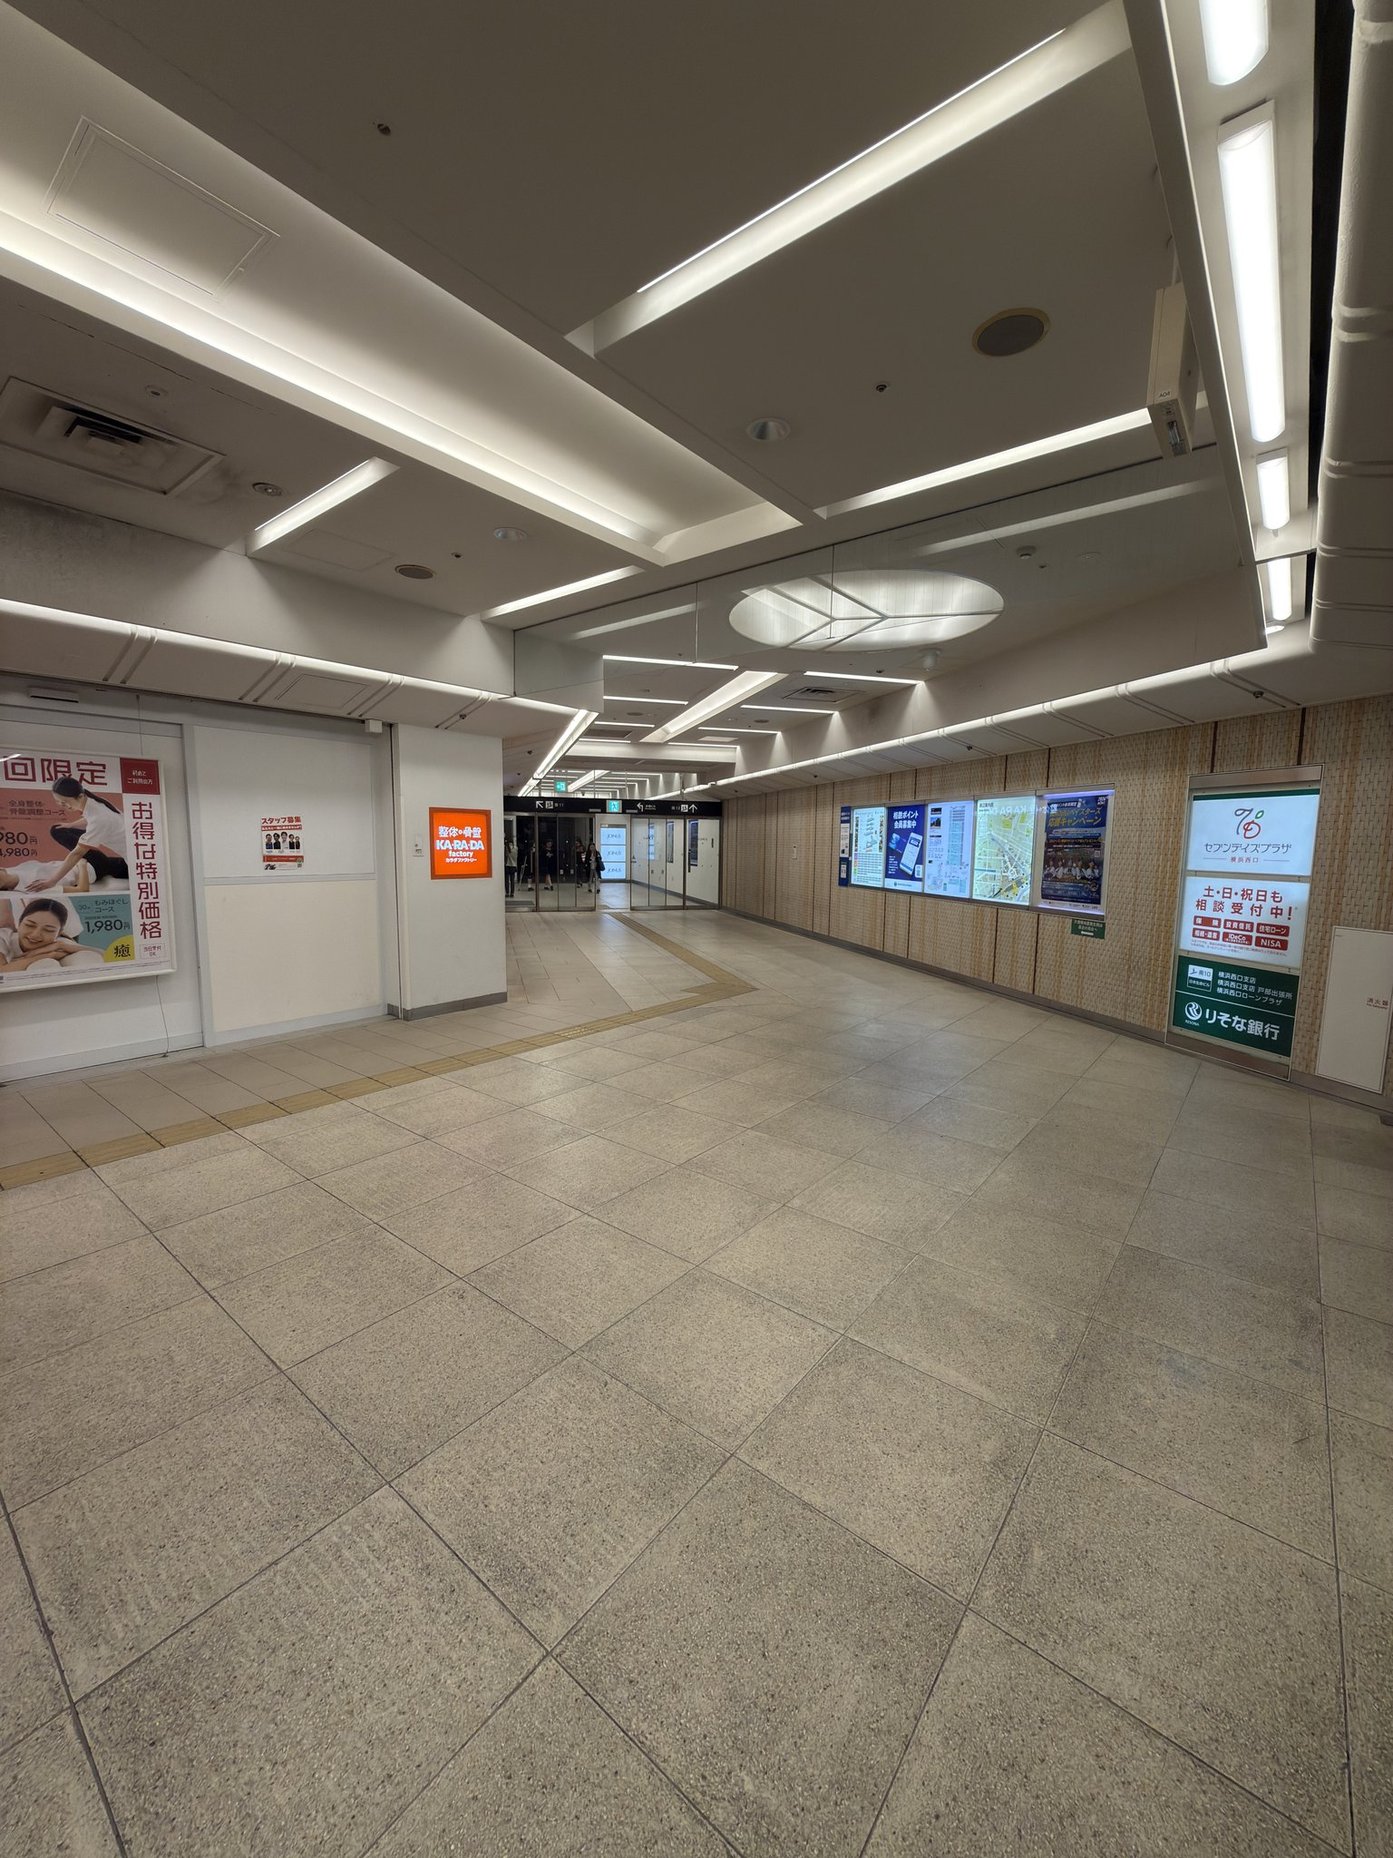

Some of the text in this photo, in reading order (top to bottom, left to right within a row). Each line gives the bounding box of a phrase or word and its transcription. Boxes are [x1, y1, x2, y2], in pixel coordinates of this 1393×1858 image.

[3, 755, 107, 786] 回限定
[261, 815, 302, 825] スタッフ募集
[448, 849, 474, 858] factory
[1204, 842, 1292, 854] セブンデイズプラザ
[131, 801, 163, 941] お得な特別価格
[1203, 885, 1283, 903] 土・日・祝日も
[1195, 899, 1294, 920] 相談受付中!
[1260, 938, 1281, 948] NISA
[1217, 979, 1256, 992] 横浜西口支店
[1218, 971, 1257, 985] 横浜西口支店
[1216, 987, 1283, 1006] 横浜西口ローンプラザ
[1205, 1008, 1280, 1041] りそな銀行
